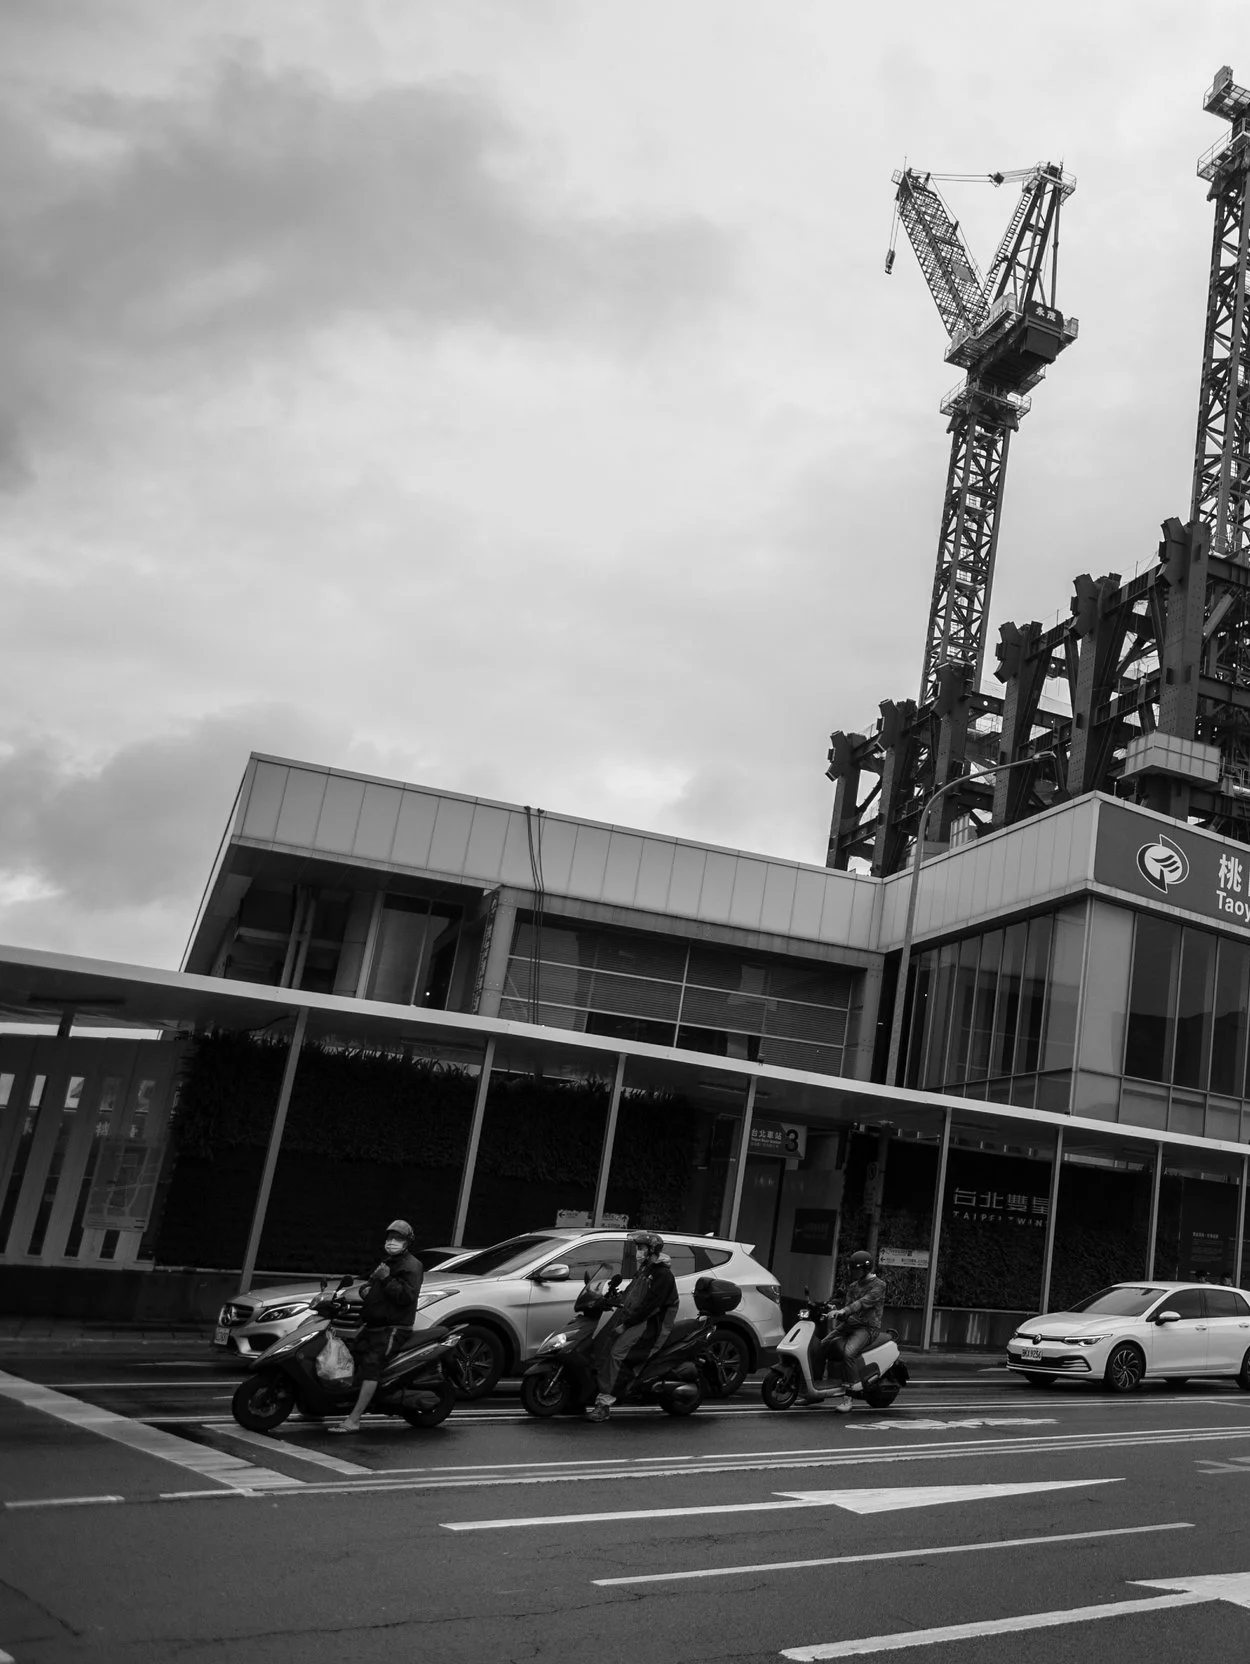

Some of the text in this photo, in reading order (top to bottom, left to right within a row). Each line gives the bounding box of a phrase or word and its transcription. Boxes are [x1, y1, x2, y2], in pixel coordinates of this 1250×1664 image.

[752, 1128, 782, 1140] 台北車站
[785, 1129, 798, 1152] 3
[952, 1210, 1049, 1228] TAIPEI TWIN
